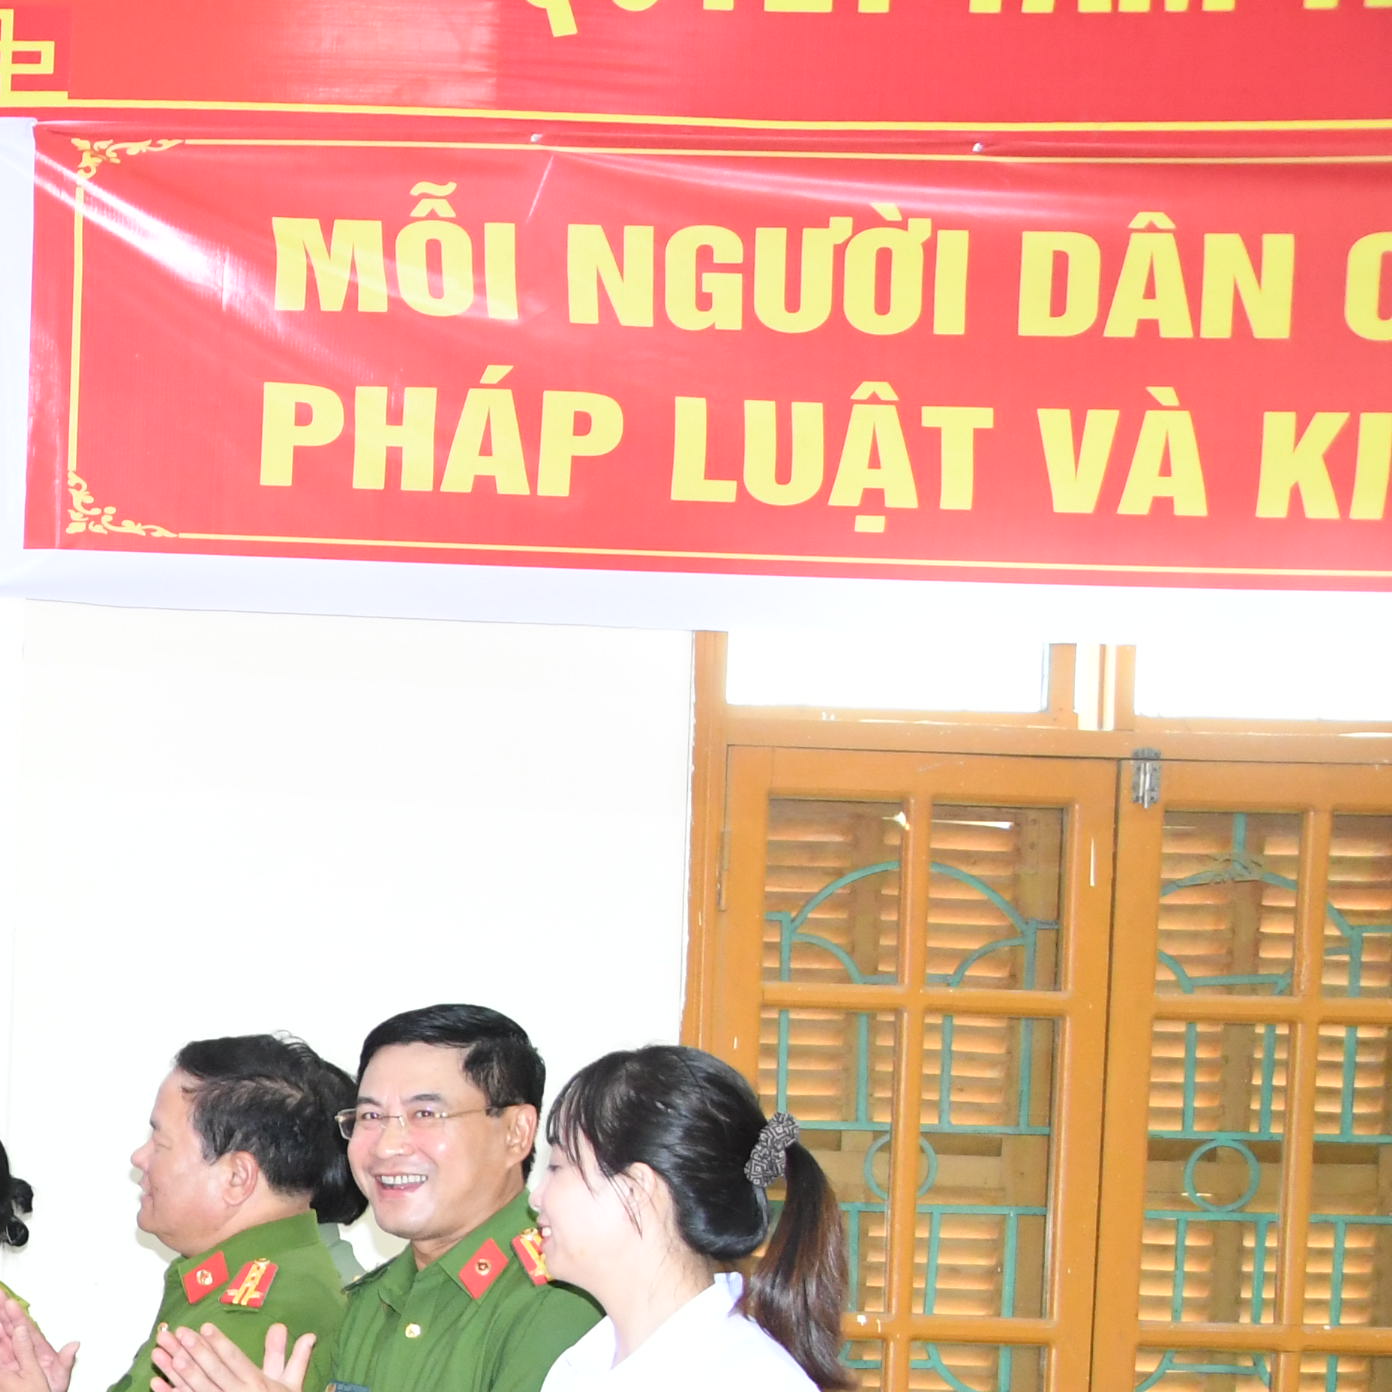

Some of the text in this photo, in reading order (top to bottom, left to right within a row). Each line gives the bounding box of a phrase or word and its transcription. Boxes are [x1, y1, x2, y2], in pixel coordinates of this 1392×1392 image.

[272, 181, 518, 319] MỖI
[568, 204, 969, 335] NGƯỜI
[1018, 212, 1294, 339] DÂN
[260, 365, 623, 497] PHÁP
[672, 381, 994, 532] LUẬT
[1038, 387, 1208, 517] VÀ
